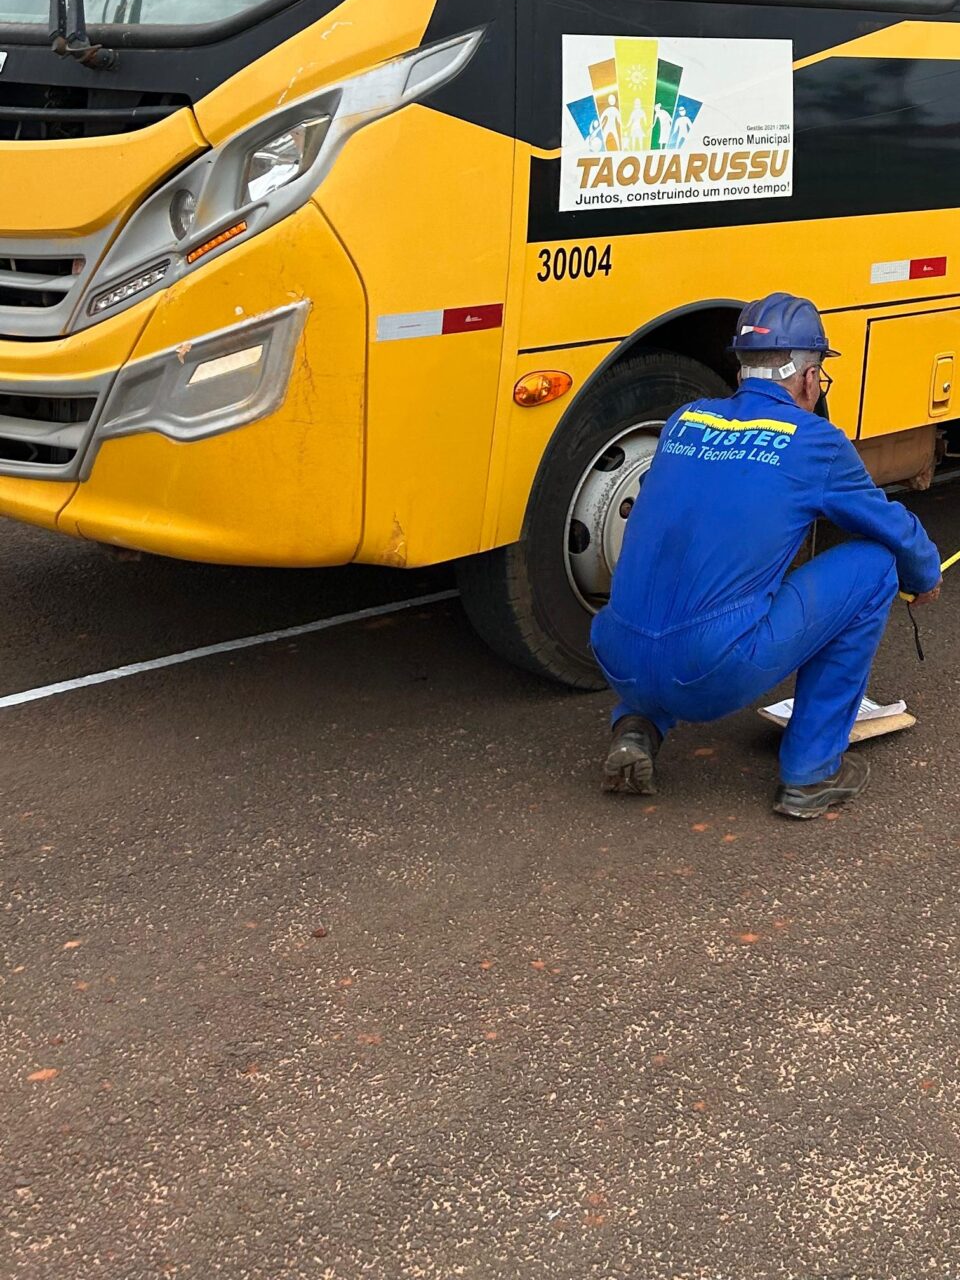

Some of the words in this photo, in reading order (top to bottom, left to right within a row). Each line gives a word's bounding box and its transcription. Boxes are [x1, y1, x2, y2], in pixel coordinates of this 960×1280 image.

[702, 136, 744, 147] Governo
[746, 134, 791, 146] Municipal
[576, 149, 790, 189] TAQUARUSSU
[575, 192, 623, 206] Juntos,
[626, 187, 700, 202] construindo
[702, 187, 720, 198] um
[723, 185, 750, 196] novo
[752, 182, 790, 195] tempo!
[536, 243, 612, 282] 30004
[701, 427, 791, 449] VISTEC
[662, 440, 697, 457] Vistoria
[698, 446, 746, 461] Técnica
[747, 447, 781, 467] Ltda.
